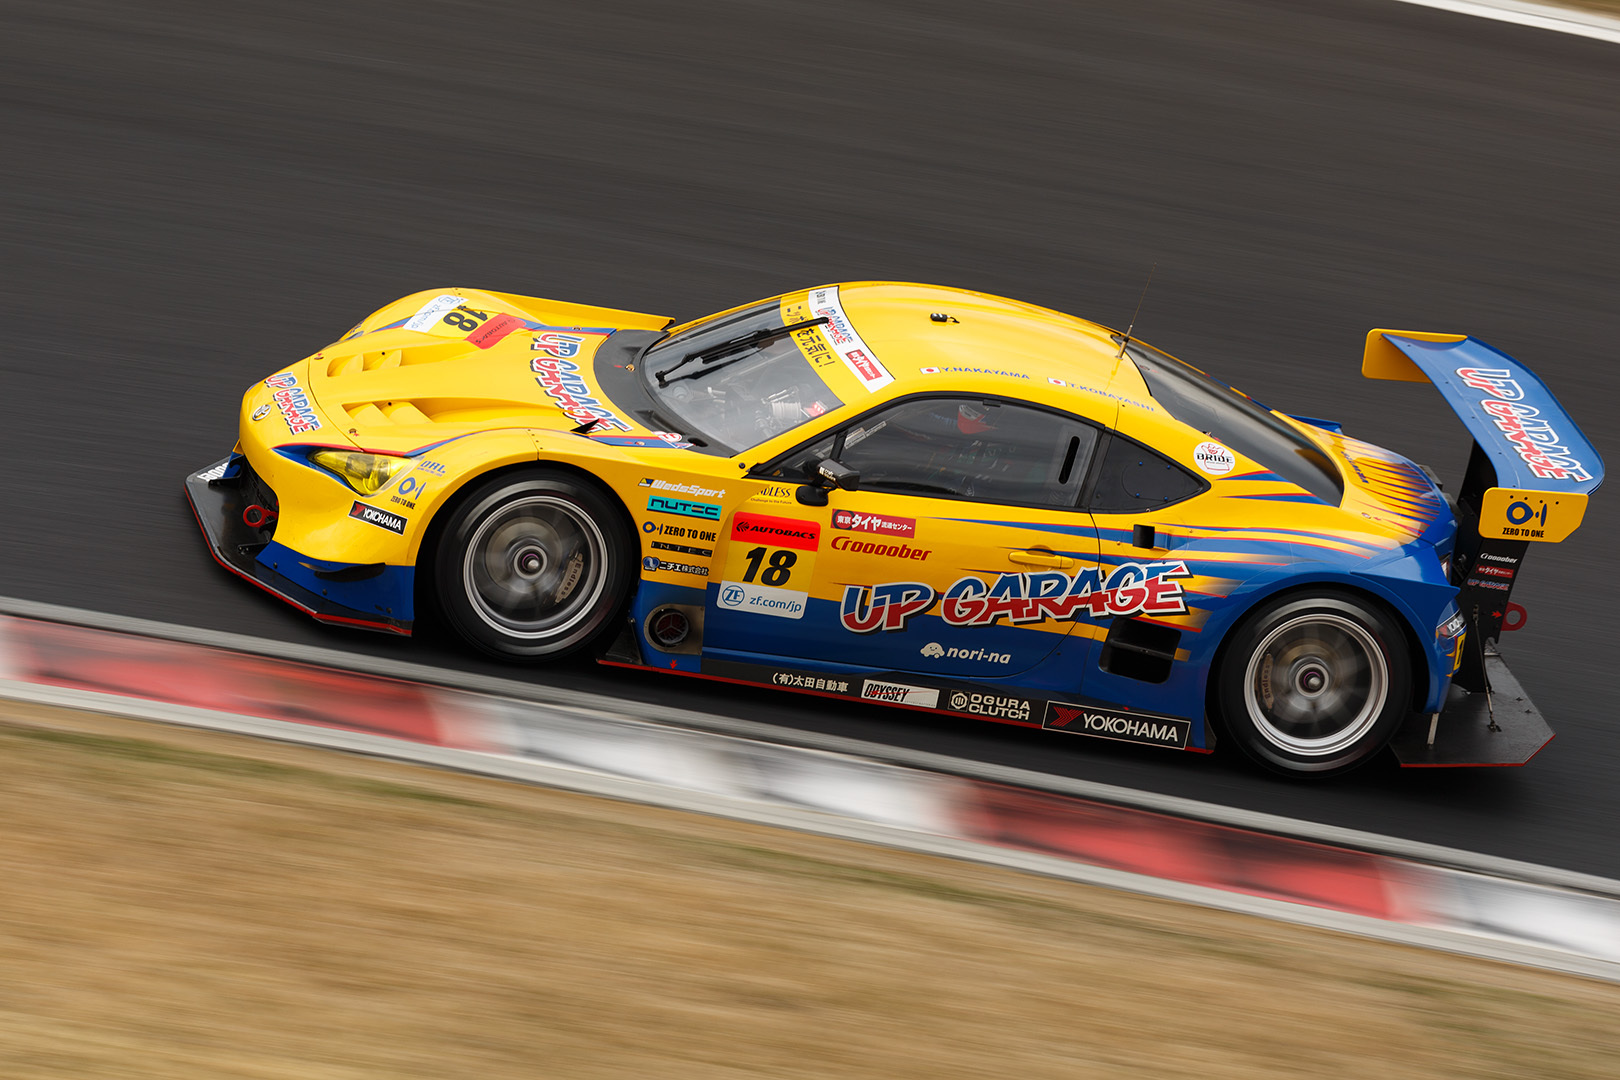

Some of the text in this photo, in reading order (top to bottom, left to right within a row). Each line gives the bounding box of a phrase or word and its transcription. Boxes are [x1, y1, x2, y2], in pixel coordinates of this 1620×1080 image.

[443, 305, 488, 332] 18
[530, 333, 634, 434] UP GARAGE
[941, 366, 1031, 380] Y.NAKAYAMA
[264, 372, 322, 435] UP GARAGE
[1068, 382, 1155, 412] T.KOBAYASHI
[1455, 367, 1594, 482] UP GARAGE
[1196, 453, 1234, 464] BRIDE
[650, 479, 726, 498] WedsSport
[363, 508, 401, 530] YOKOHAMA
[664, 525, 717, 542] ZERO TO ONE
[750, 525, 816, 540] AUTOBACS
[1502, 527, 1544, 538] ZERO TO ONE
[831, 536, 932, 561] Croooober
[742, 546, 798, 587] 18
[723, 587, 802, 613] ZF zf.com/jp
[840, 560, 1193, 635] UP GARAGE
[946, 648, 1011, 665] nori-na
[772, 672, 849, 693] (有)太田自動車
[864, 682, 911, 703] ODYSSEY
[968, 703, 1030, 720] CLUTCH
[970, 693, 1031, 710] OGURA
[1082, 712, 1179, 742] YOKOHAMA
